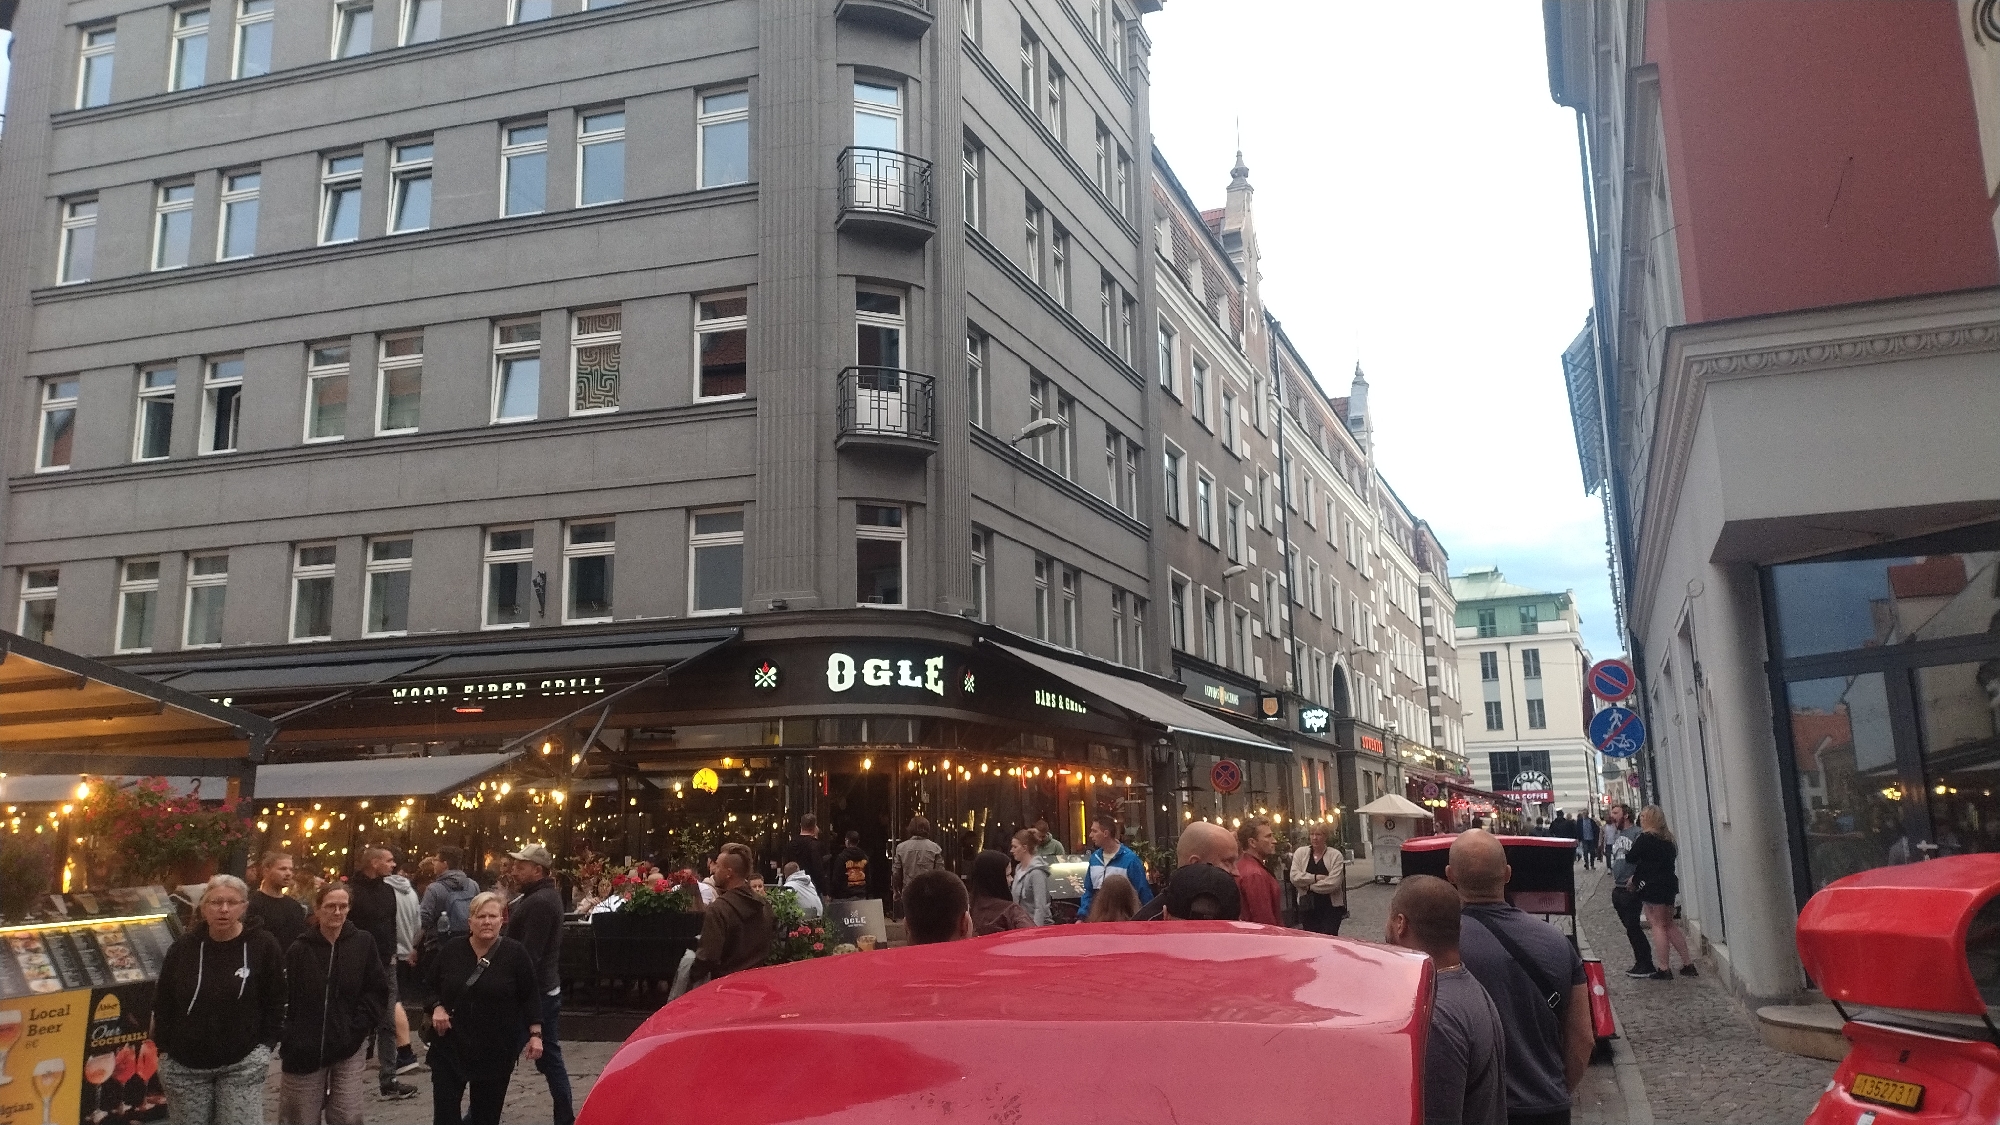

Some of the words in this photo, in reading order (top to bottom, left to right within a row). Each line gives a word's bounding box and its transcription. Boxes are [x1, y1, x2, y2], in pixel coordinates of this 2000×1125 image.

[826, 652, 944, 697] OGLE
[392, 687, 448, 705] WOOD
[462, 682, 526, 701] FIRED
[541, 677, 604, 696] GRILL
[1058, 694, 1064, 710] &
[1516, 770, 1544, 784] COSTA
[1521, 793, 1548, 801] COFFEE
[29, 1004, 71, 1021] Local
[26, 1022, 63, 1037] Beer
[91, 1025, 121, 1041] Our
[91, 1031, 148, 1048] COCKTAILS
